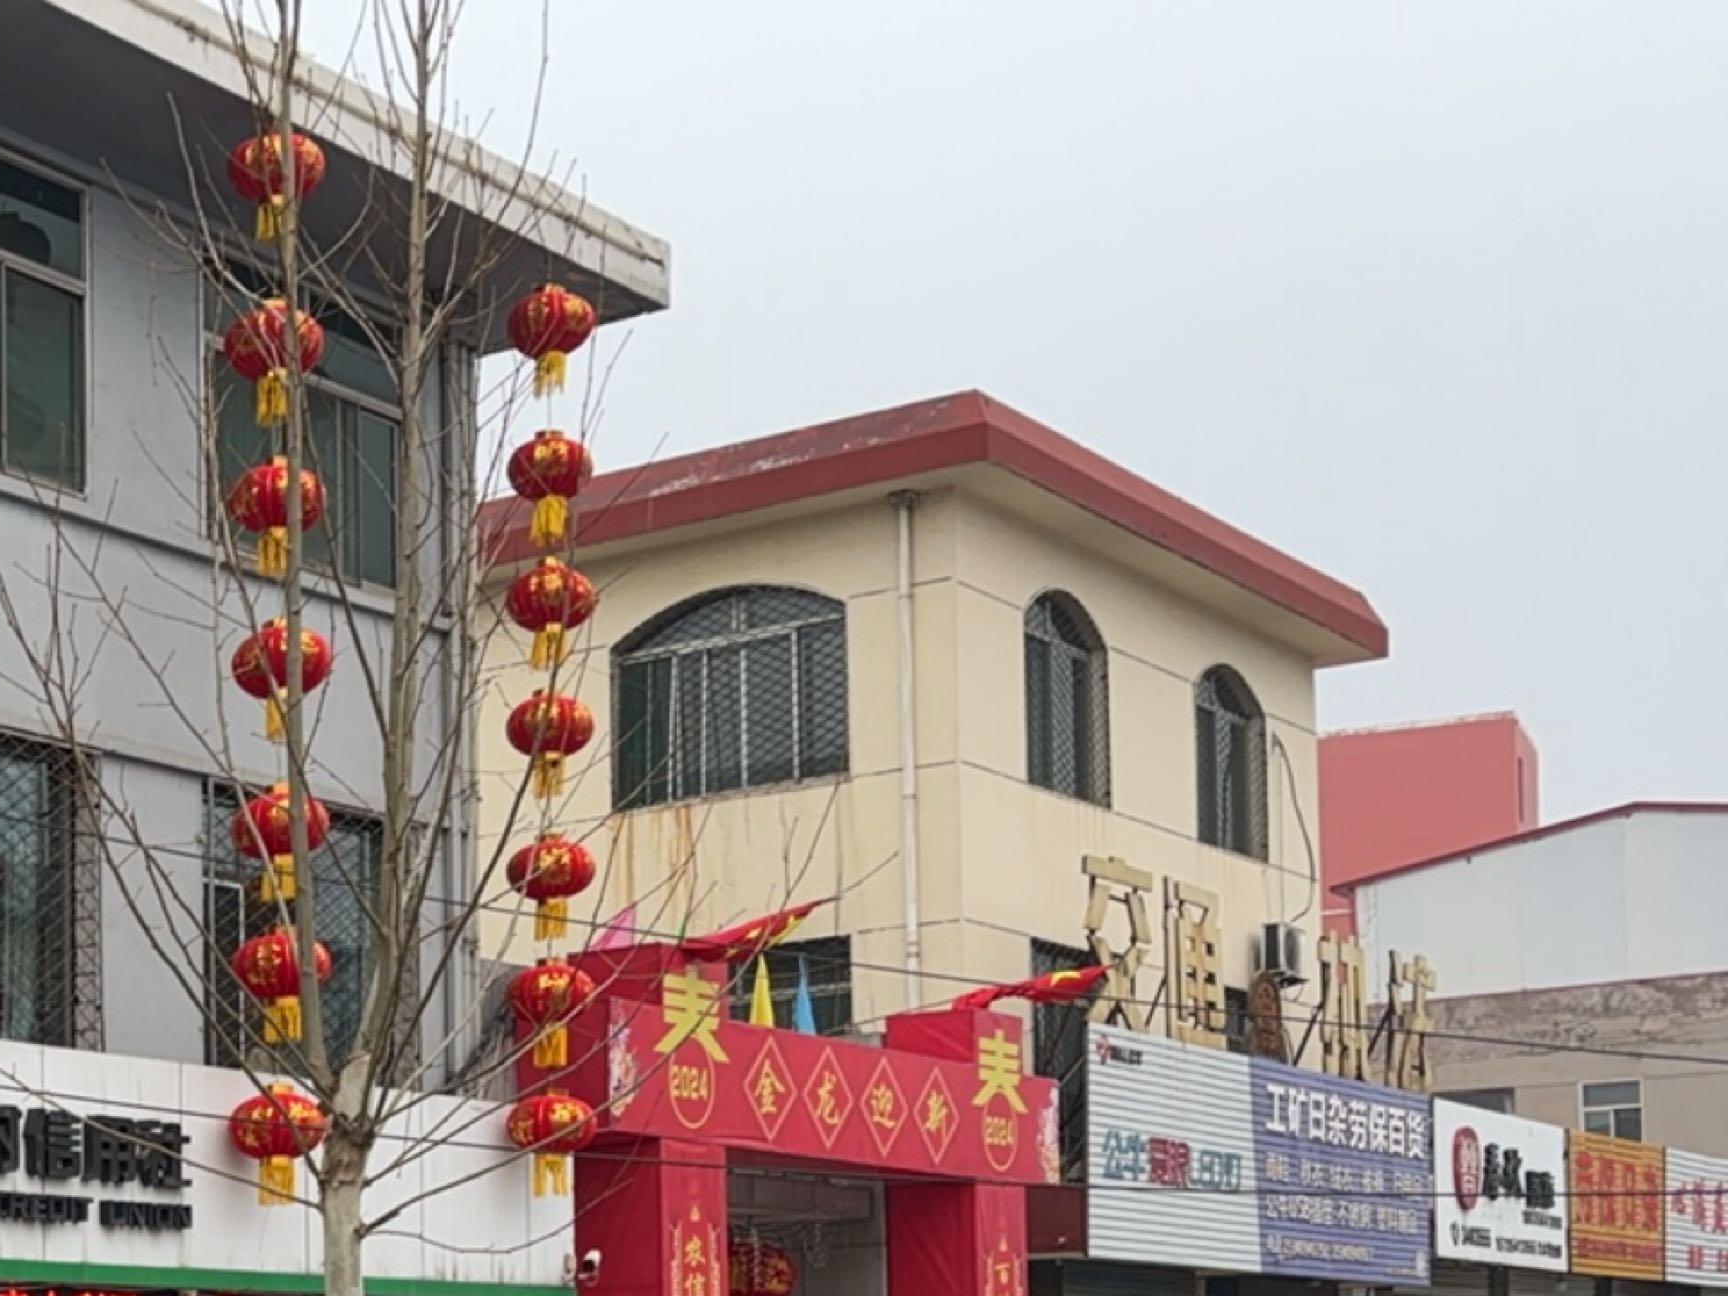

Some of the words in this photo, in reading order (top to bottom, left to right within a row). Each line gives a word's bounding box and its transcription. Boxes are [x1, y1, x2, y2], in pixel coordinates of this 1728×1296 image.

[670, 1064, 709, 1101] 2024
[754, 1057, 951, 1138] 金龙迎新
[984, 1116, 1015, 1147] 2024
[1266, 1081, 1426, 1161] 工矿日杂劳保百货
[99, 1200, 193, 1231] UNION
